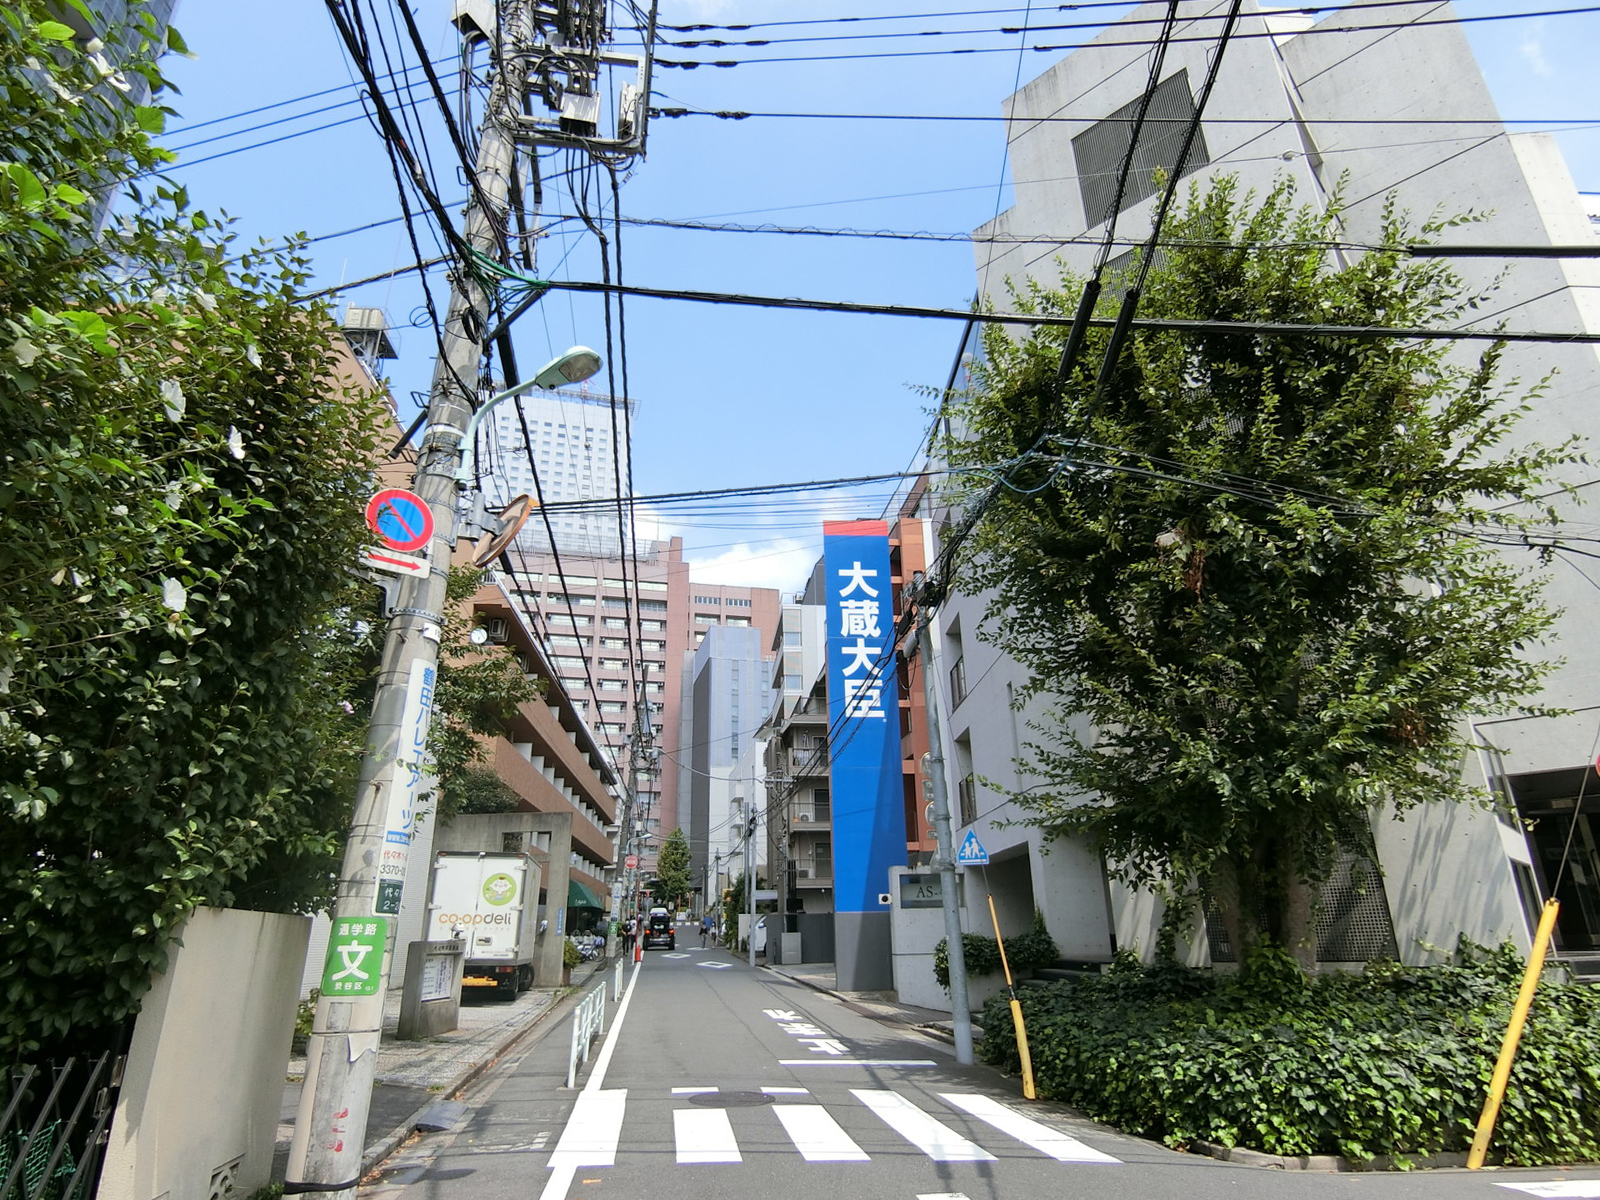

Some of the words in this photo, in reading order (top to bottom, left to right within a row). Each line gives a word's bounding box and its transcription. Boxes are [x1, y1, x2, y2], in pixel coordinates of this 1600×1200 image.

[838, 561, 885, 718] 大蔵大臣
[917, 886, 942, 898] AS-
[338, 923, 378, 936] 通学路
[332, 940, 373, 981] 文
[334, 981, 363, 991] 渋谷区
